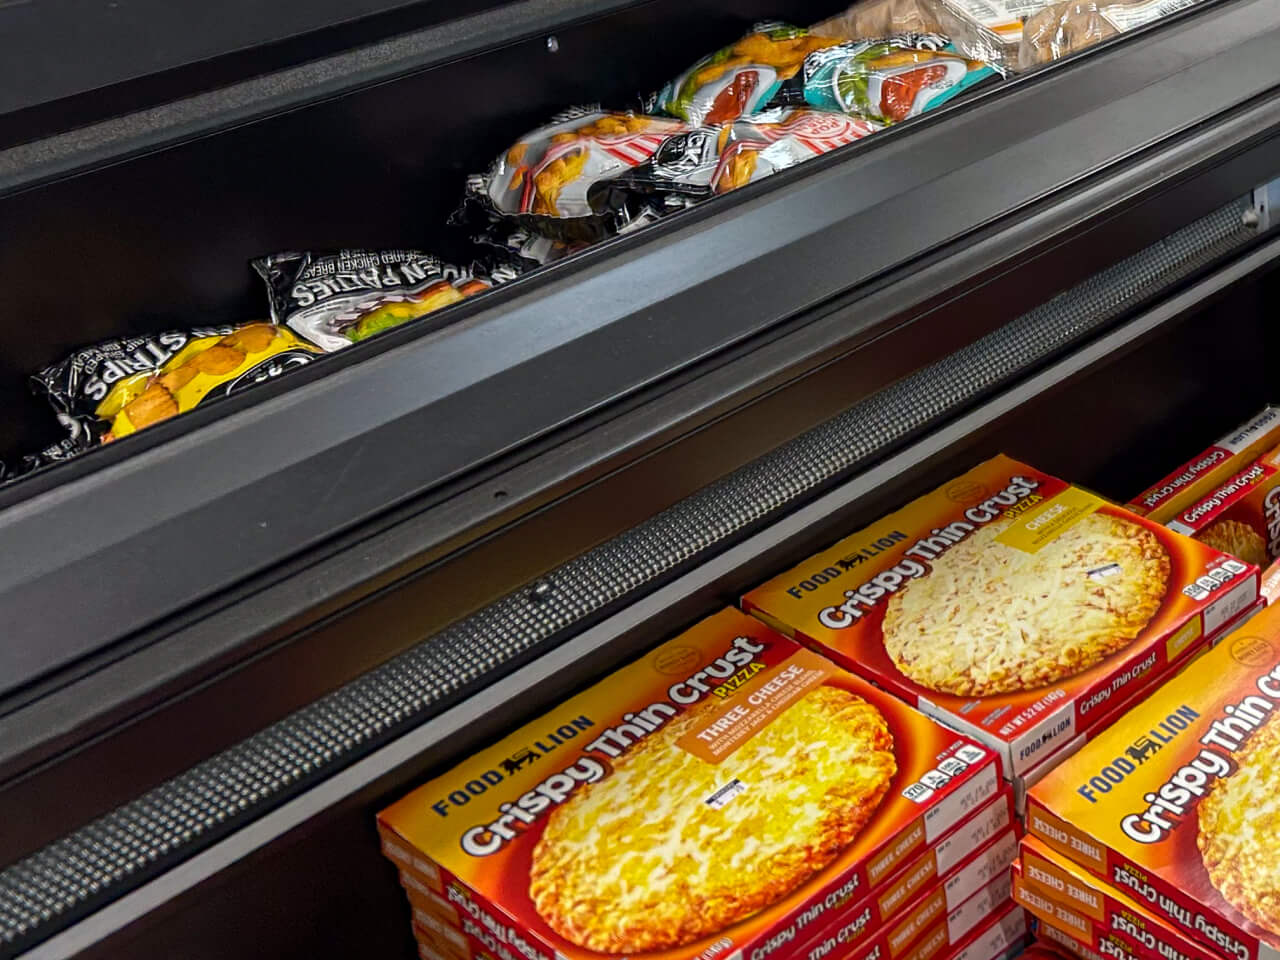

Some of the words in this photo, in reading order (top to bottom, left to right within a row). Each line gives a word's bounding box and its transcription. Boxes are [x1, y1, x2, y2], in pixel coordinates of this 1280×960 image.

[303, 263, 336, 280] BREAS
[336, 256, 381, 273] CHICKEN
[291, 266, 402, 307] PATTIES
[84, 331, 188, 401] STRIPS
[1002, 494, 1043, 520] PIZZA
[1183, 496, 1220, 524] Crispy
[1215, 482, 1239, 503] Thin
[1236, 464, 1265, 487] Crust
[1025, 502, 1066, 531] CHEESE
[786, 566, 842, 600] FOOD
[861, 529, 908, 559] LION
[818, 555, 929, 631] Crispy
[904, 516, 968, 561] Thin
[963, 474, 1042, 526] Crust
[714, 661, 768, 701] PIZZA
[1078, 682, 1111, 715] Crispy
[1110, 665, 1134, 693] Thin
[1132, 650, 1158, 678] Crust
[696, 704, 749, 744] THREE
[747, 664, 805, 708] CHEESE
[460, 755, 607, 858] Crispy
[584, 699, 678, 758] Thin
[668, 634, 764, 706] Crust
[1019, 740, 1043, 761] FOOD
[1050, 717, 1071, 738] LION
[1077, 754, 1137, 804] FOOD
[1150, 704, 1201, 746] LION
[431, 768, 504, 819] FOOD
[537, 714, 596, 755] LION
[1119, 748, 1233, 845] Crispy
[1200, 694, 1272, 756] Thin
[905, 783, 923, 799] 370
[1031, 814, 1071, 847] CHEESE
[1068, 833, 1103, 864] THREE
[868, 853, 896, 880] THREE
[893, 827, 923, 856] CHEESE
[1124, 860, 1149, 883] PIZZA
[880, 884, 906, 912] THREE
[905, 860, 934, 888] CHEESE
[1026, 863, 1065, 895] CHEESE
[1065, 877, 1100, 909] THREE
[1113, 865, 1158, 902] Crust
[750, 924, 798, 960] Crispy
[795, 906, 825, 930] Thin
[823, 872, 860, 910] Crust
[1017, 884, 1056, 919] CHEESE
[1054, 905, 1087, 935] THREE
[1119, 908, 1147, 929] PIZZA
[1157, 887, 1198, 929] Thin
[808, 934, 839, 960] Thin
[836, 906, 872, 943] Crust
[1110, 912, 1157, 955] Crust
[1195, 916, 1251, 960] Crispy
